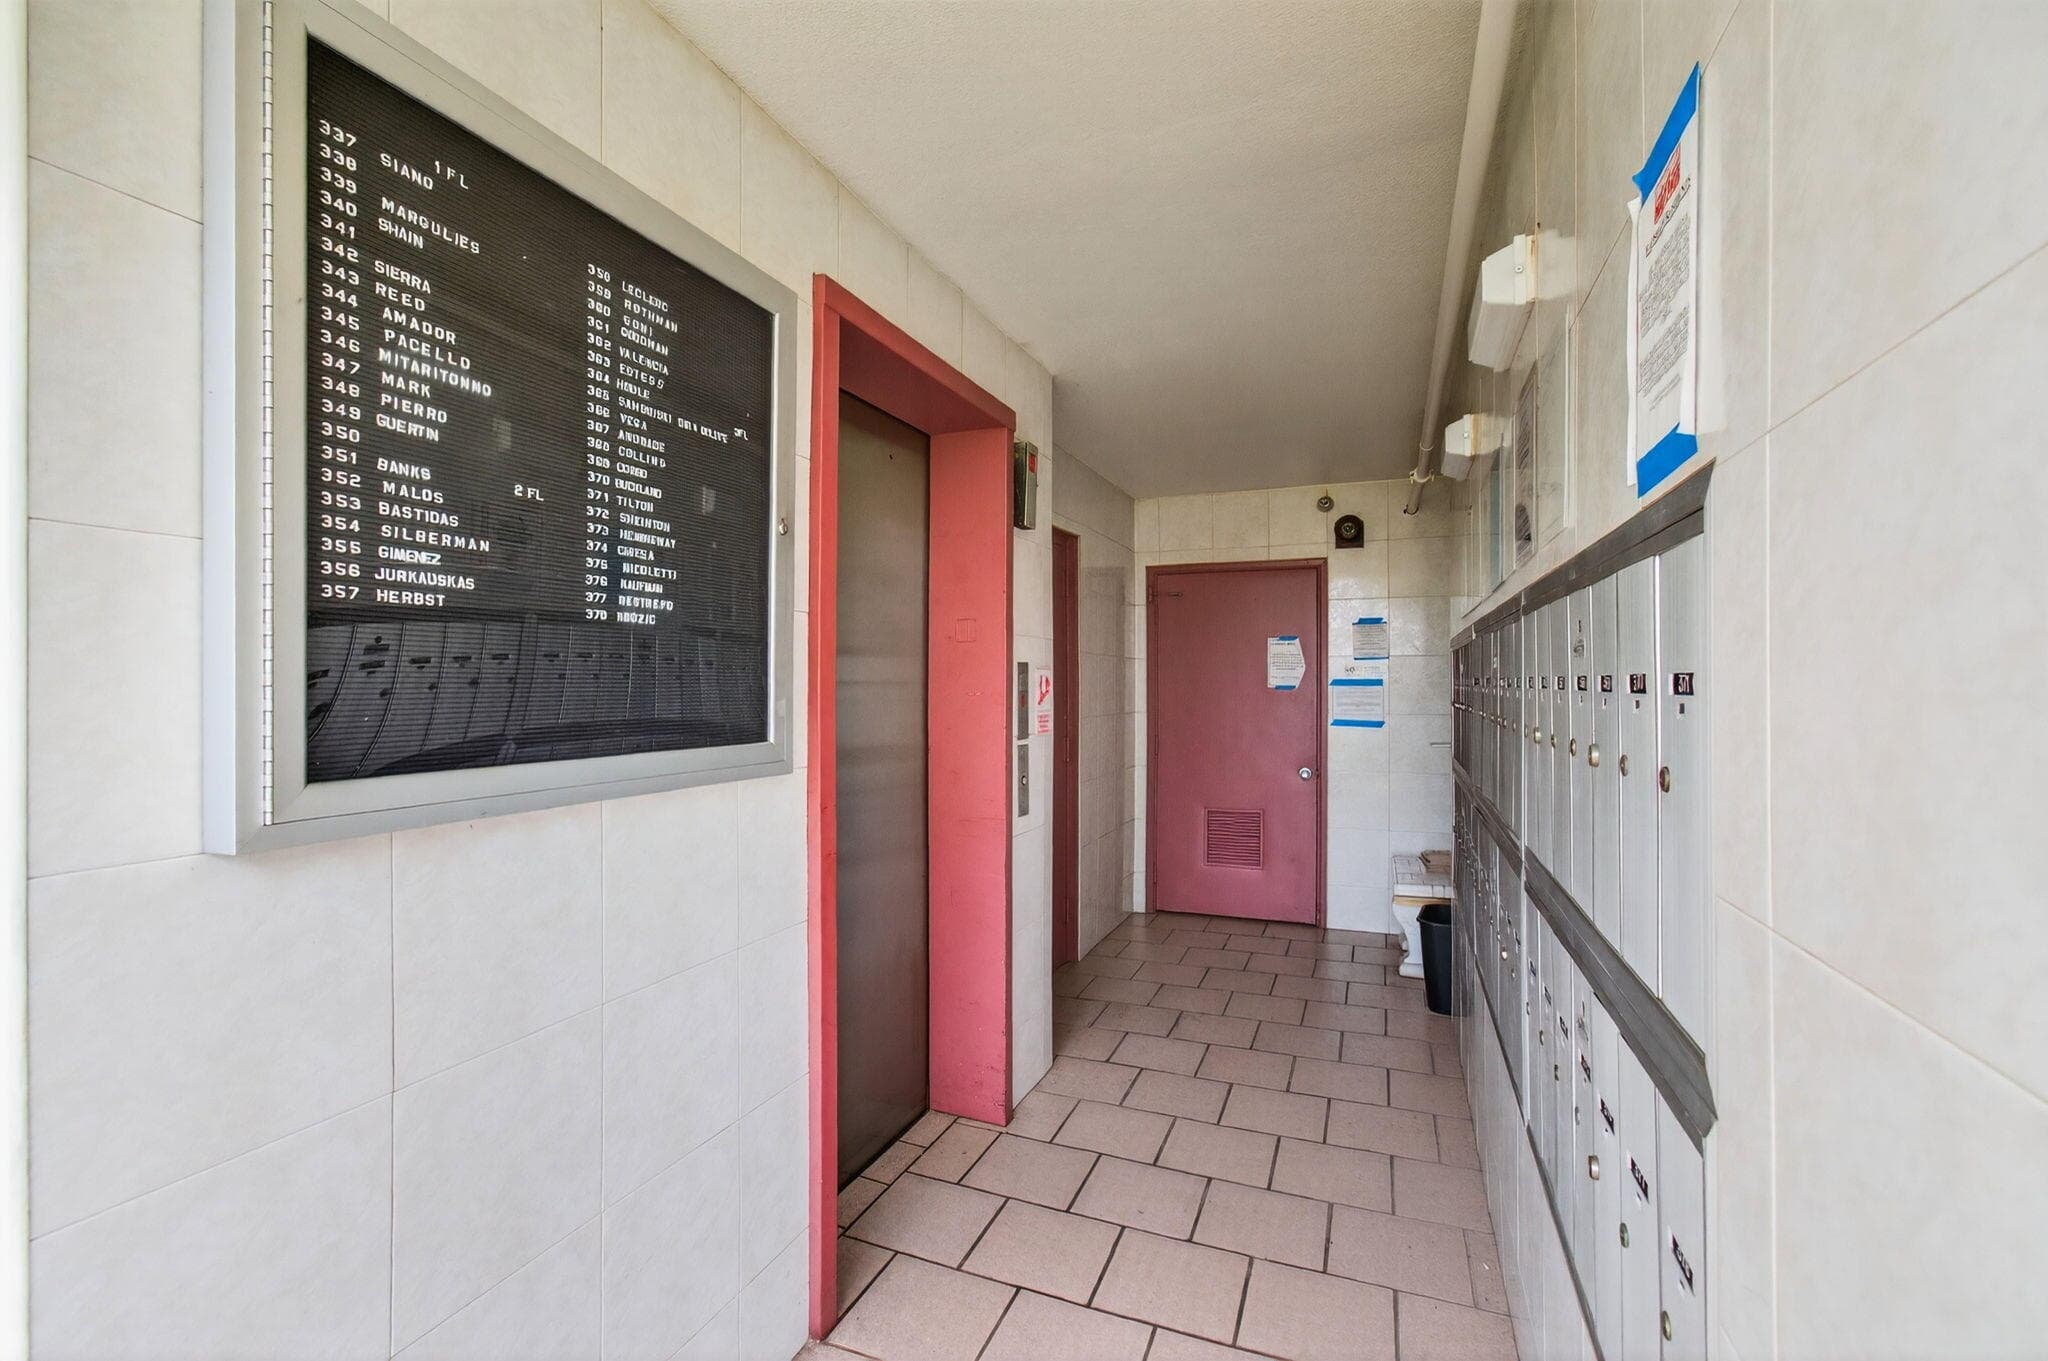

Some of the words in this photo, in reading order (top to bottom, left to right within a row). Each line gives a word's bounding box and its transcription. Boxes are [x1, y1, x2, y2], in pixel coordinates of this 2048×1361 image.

[318, 119, 357, 148] 337
[380, 152, 434, 191] SIANO
[319, 143, 357, 171] 338
[319, 166, 358, 194] 339
[381, 197, 481, 254] MARGULIES
[319, 190, 358, 217] 340
[378, 218, 425, 249] SHAIN
[319, 213, 356, 239] 341
[320, 237, 359, 263] 342
[374, 260, 432, 295] SIERRA
[321, 260, 360, 285] 343
[374, 282, 427, 312] REED
[321, 283, 359, 308] 344
[382, 307, 457, 345] AMADOR
[320, 329, 361, 353] 346
[321, 306, 360, 331] 345
[384, 329, 471, 371] PACELLO
[321, 352, 361, 376] 347
[381, 371, 431, 398] MARK
[320, 376, 360, 398] 348
[380, 393, 448, 423] PIERRO
[320, 399, 361, 421] 349
[320, 422, 360, 444] 350
[320, 445, 357, 465] 351
[376, 458, 432, 481] BANKS
[320, 468, 361, 488] 352
[320, 491, 361, 511] 353
[378, 501, 459, 527] BASTIDAS
[514, 484, 523, 497] 2
[527, 488, 544, 502] FL
[320, 514, 361, 533] 354
[380, 525, 490, 552] SILBERMAN
[320, 537, 362, 554] 355
[320, 561, 361, 577] 356
[374, 568, 476, 590] JURKAUSKAS
[320, 584, 360, 600] 357
[376, 589, 446, 607] HERBST
